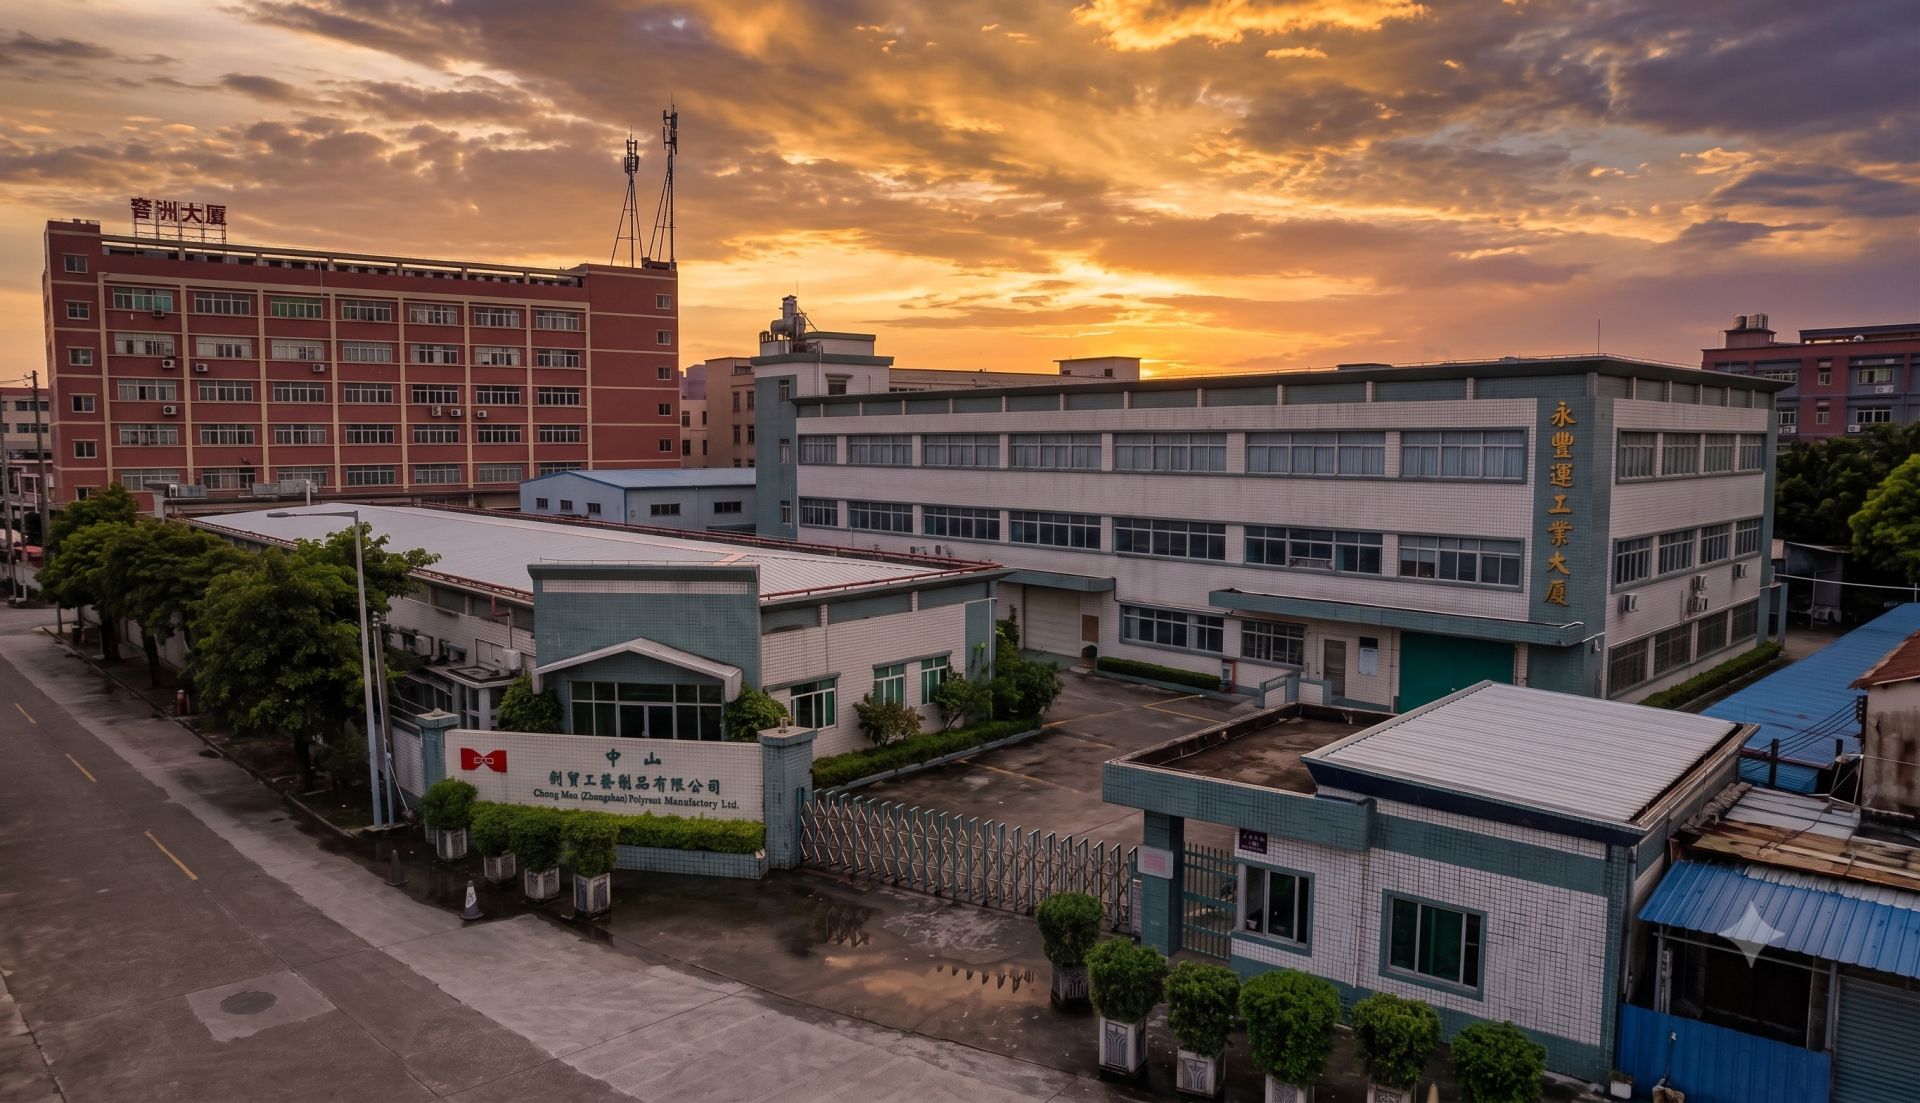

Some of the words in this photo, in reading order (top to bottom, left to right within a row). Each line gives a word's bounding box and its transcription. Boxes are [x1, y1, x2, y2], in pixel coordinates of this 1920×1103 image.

[606, 748, 661, 767] 中山
[533, 788, 559, 801] Chong
[664, 796, 718, 810] Manufactory
[721, 800, 740, 809] Ltd.
